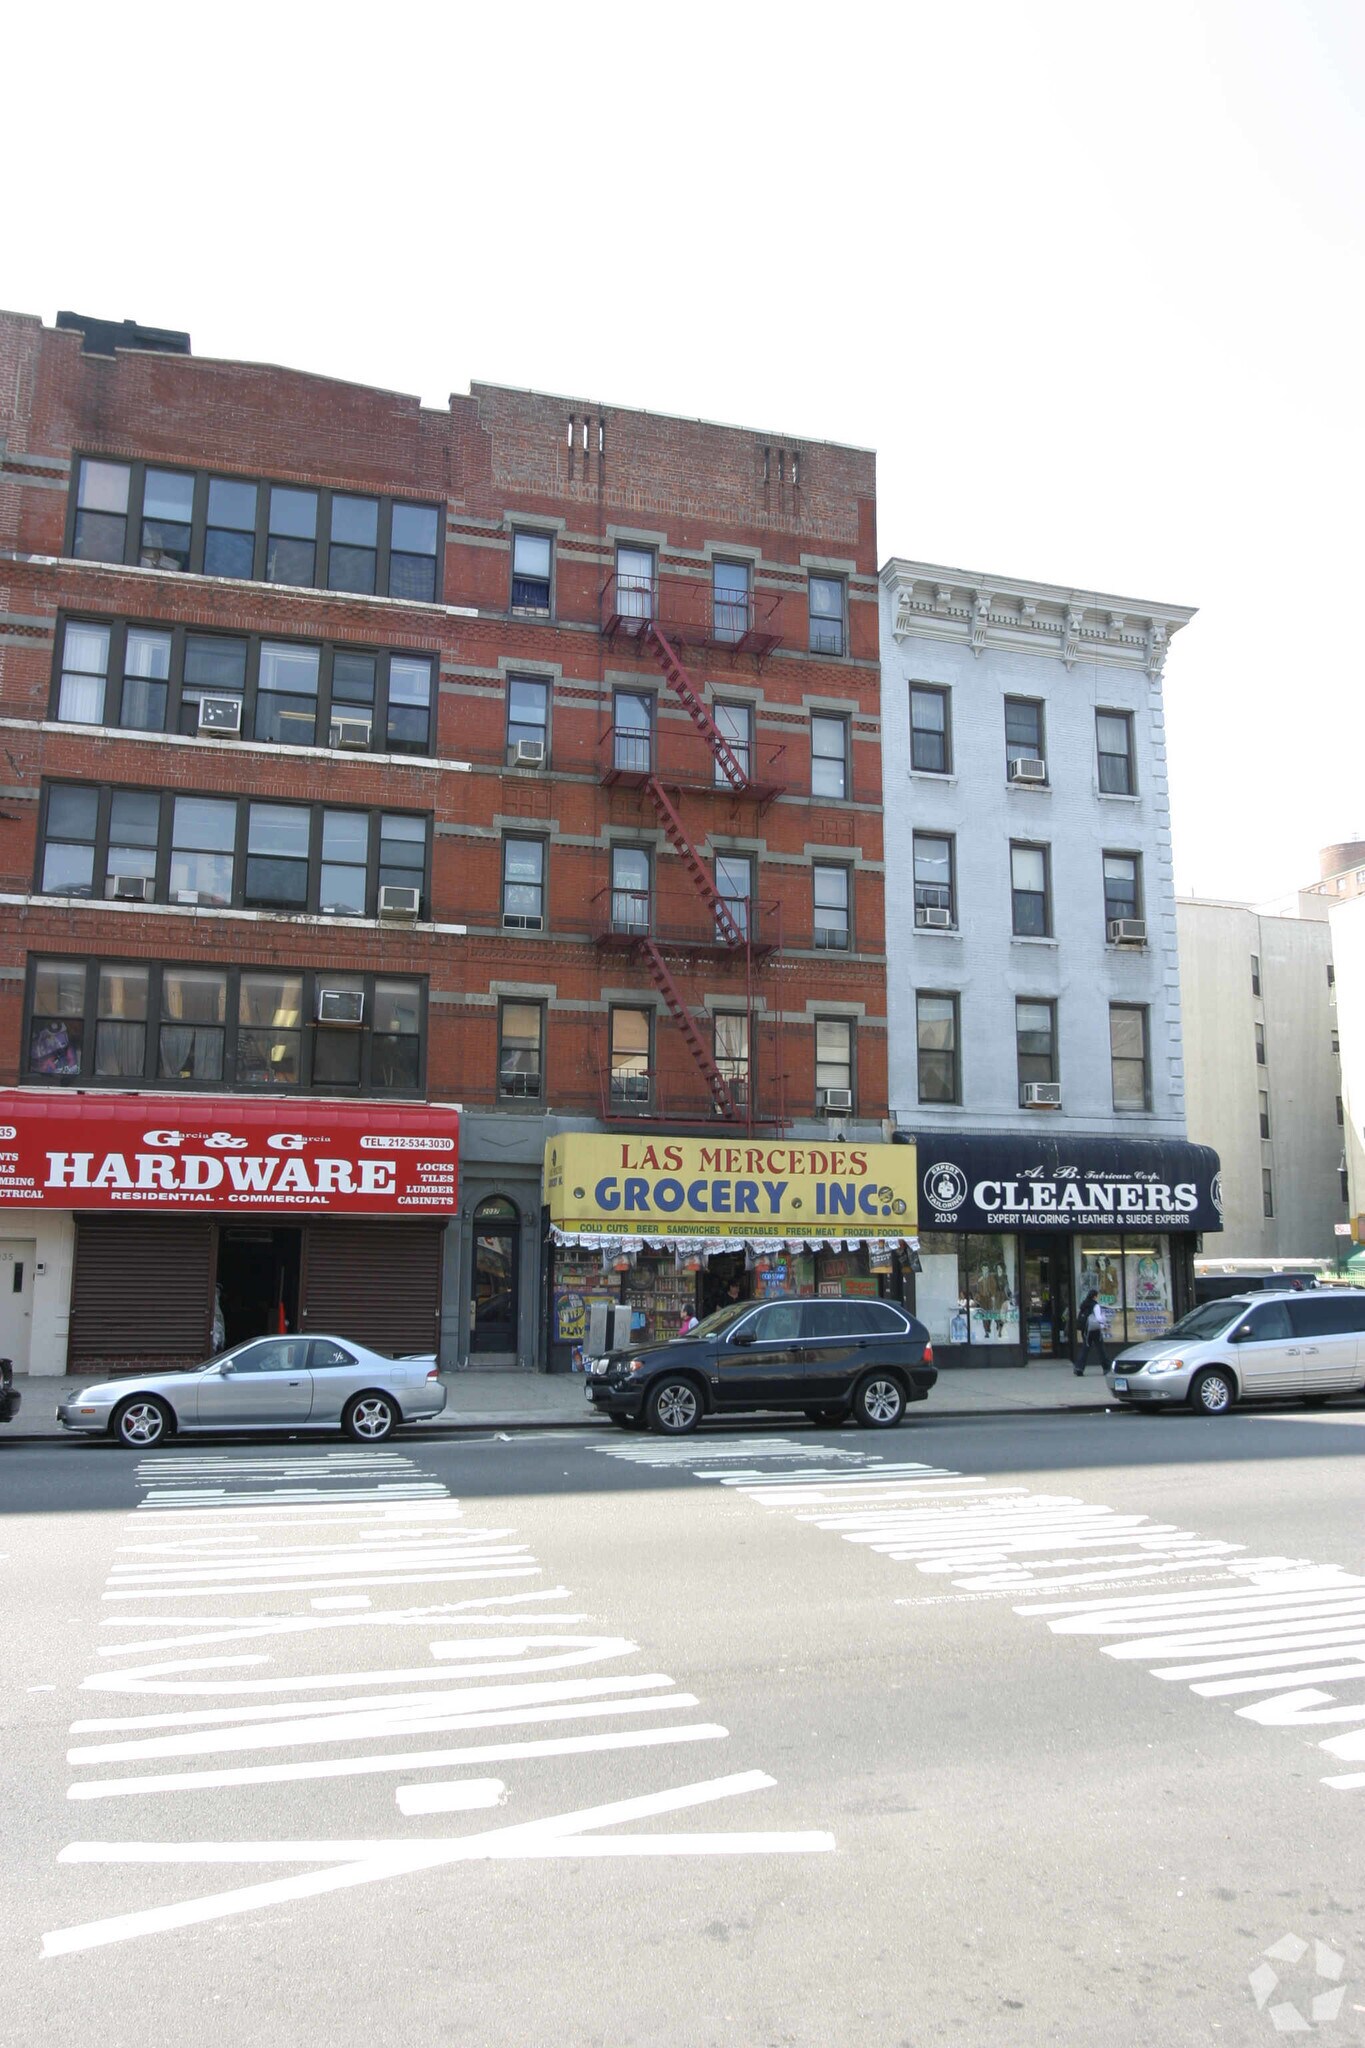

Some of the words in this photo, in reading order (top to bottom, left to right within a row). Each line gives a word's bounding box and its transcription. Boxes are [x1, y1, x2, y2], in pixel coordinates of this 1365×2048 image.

[365, 1137, 386, 1147] TEL.
[389, 1138, 451, 1149] 212-534-3030
[620, 1143, 683, 1172] LAS
[698, 1147, 868, 1176] MERCEDES
[44, 1152, 396, 1195] HARDWARE
[416, 1163, 454, 1172] LOCKS
[931, 1164, 960, 1176] EXPERT
[420, 1174, 454, 1183] TILES
[406, 1185, 454, 1194] LUMBER
[111, 1191, 215, 1202] RESIDENTIAL
[228, 1193, 330, 1204] COMMERCIAL
[397, 1196, 454, 1206] CABINETS
[594, 1176, 789, 1213] GROCERY
[815, 1182, 892, 1217] INC.
[928, 1194, 963, 1209] TAILORING
[973, 1180, 1199, 1212] CLEANERS
[935, 1213, 958, 1223] 2039
[987, 1213, 1019, 1224] EXPERT
[1021, 1214, 1070, 1224] TAILORING
[1078, 1214, 1115, 1224] LEATHER
[1116, 1214, 1124, 1224] &
[1125, 1214, 1153, 1225] SUEDE
[1155, 1214, 1190, 1225] EXPERTS
[580, 1223, 603, 1233] COLD
[606, 1224, 629, 1233] CUTS
[636, 1224, 659, 1234] BEER
[667, 1224, 721, 1235] SANDWICHES
[728, 1226, 779, 1236] VEGETABLES
[785, 1227, 812, 1236] FRESH
[815, 1228, 837, 1237] MEAT
[843, 1228, 874, 1238] FROZEN
[877, 1229, 904, 1238] FOODS
